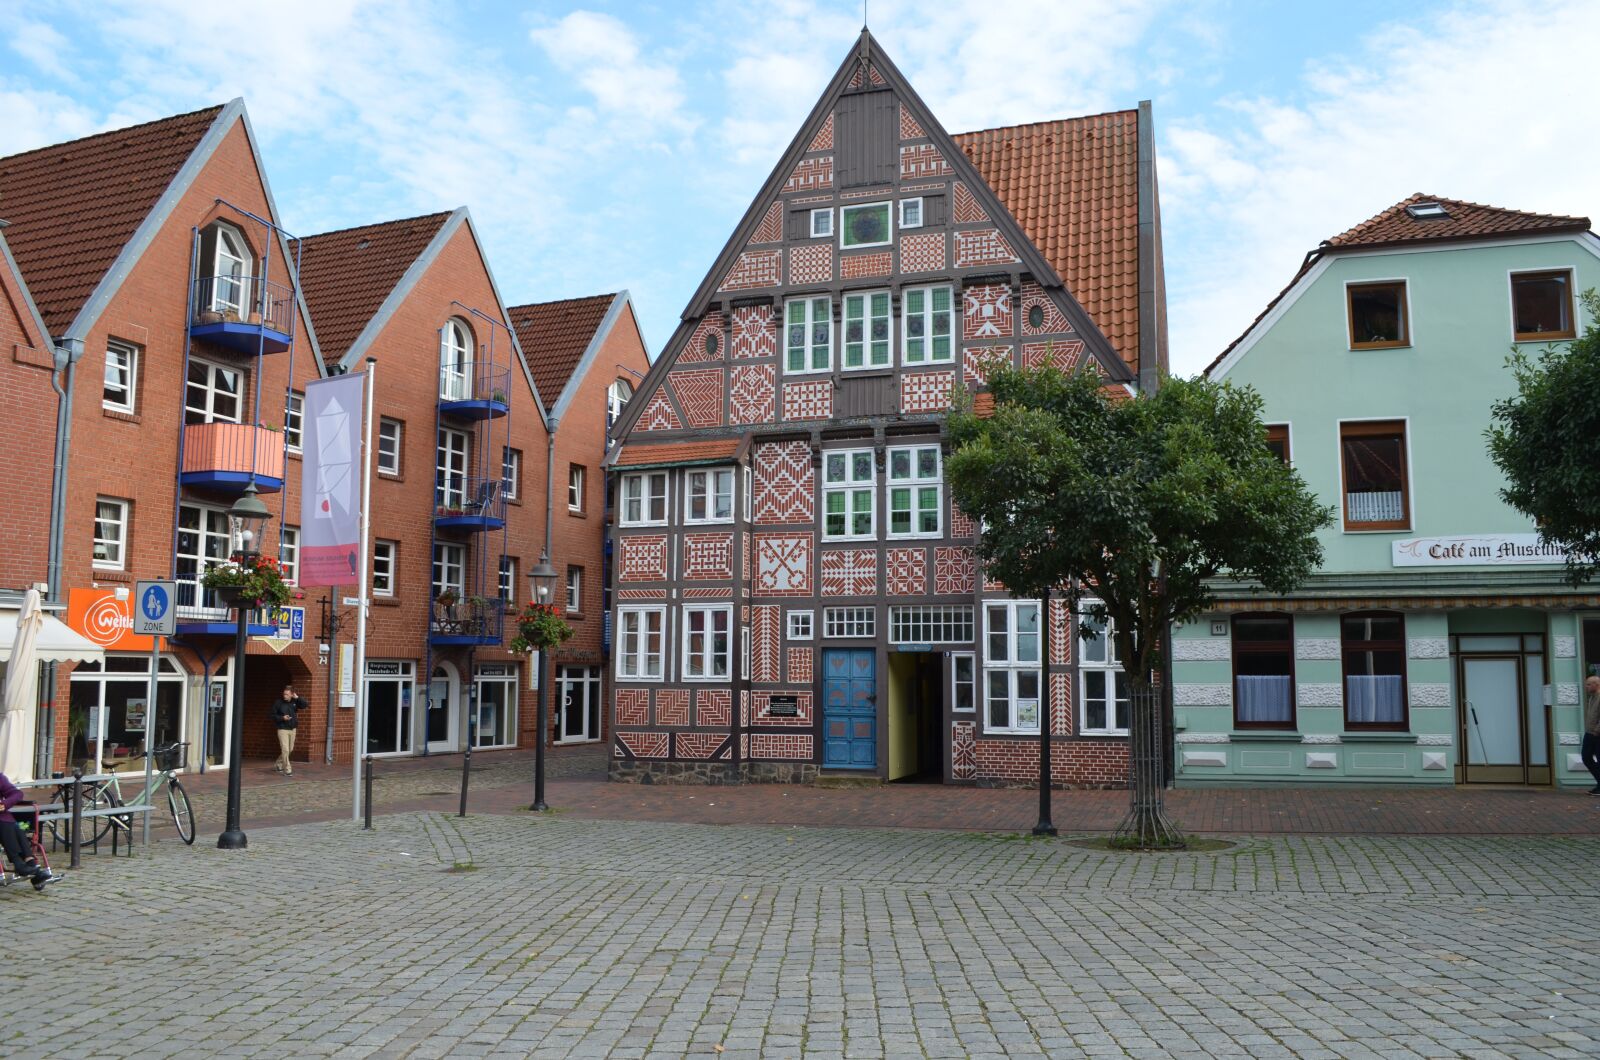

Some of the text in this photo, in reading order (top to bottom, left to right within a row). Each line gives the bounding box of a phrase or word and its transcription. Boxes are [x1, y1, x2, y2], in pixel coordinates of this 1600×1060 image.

[1428, 541, 1565, 560] Café am Museum
[143, 622, 164, 632] ZONE
